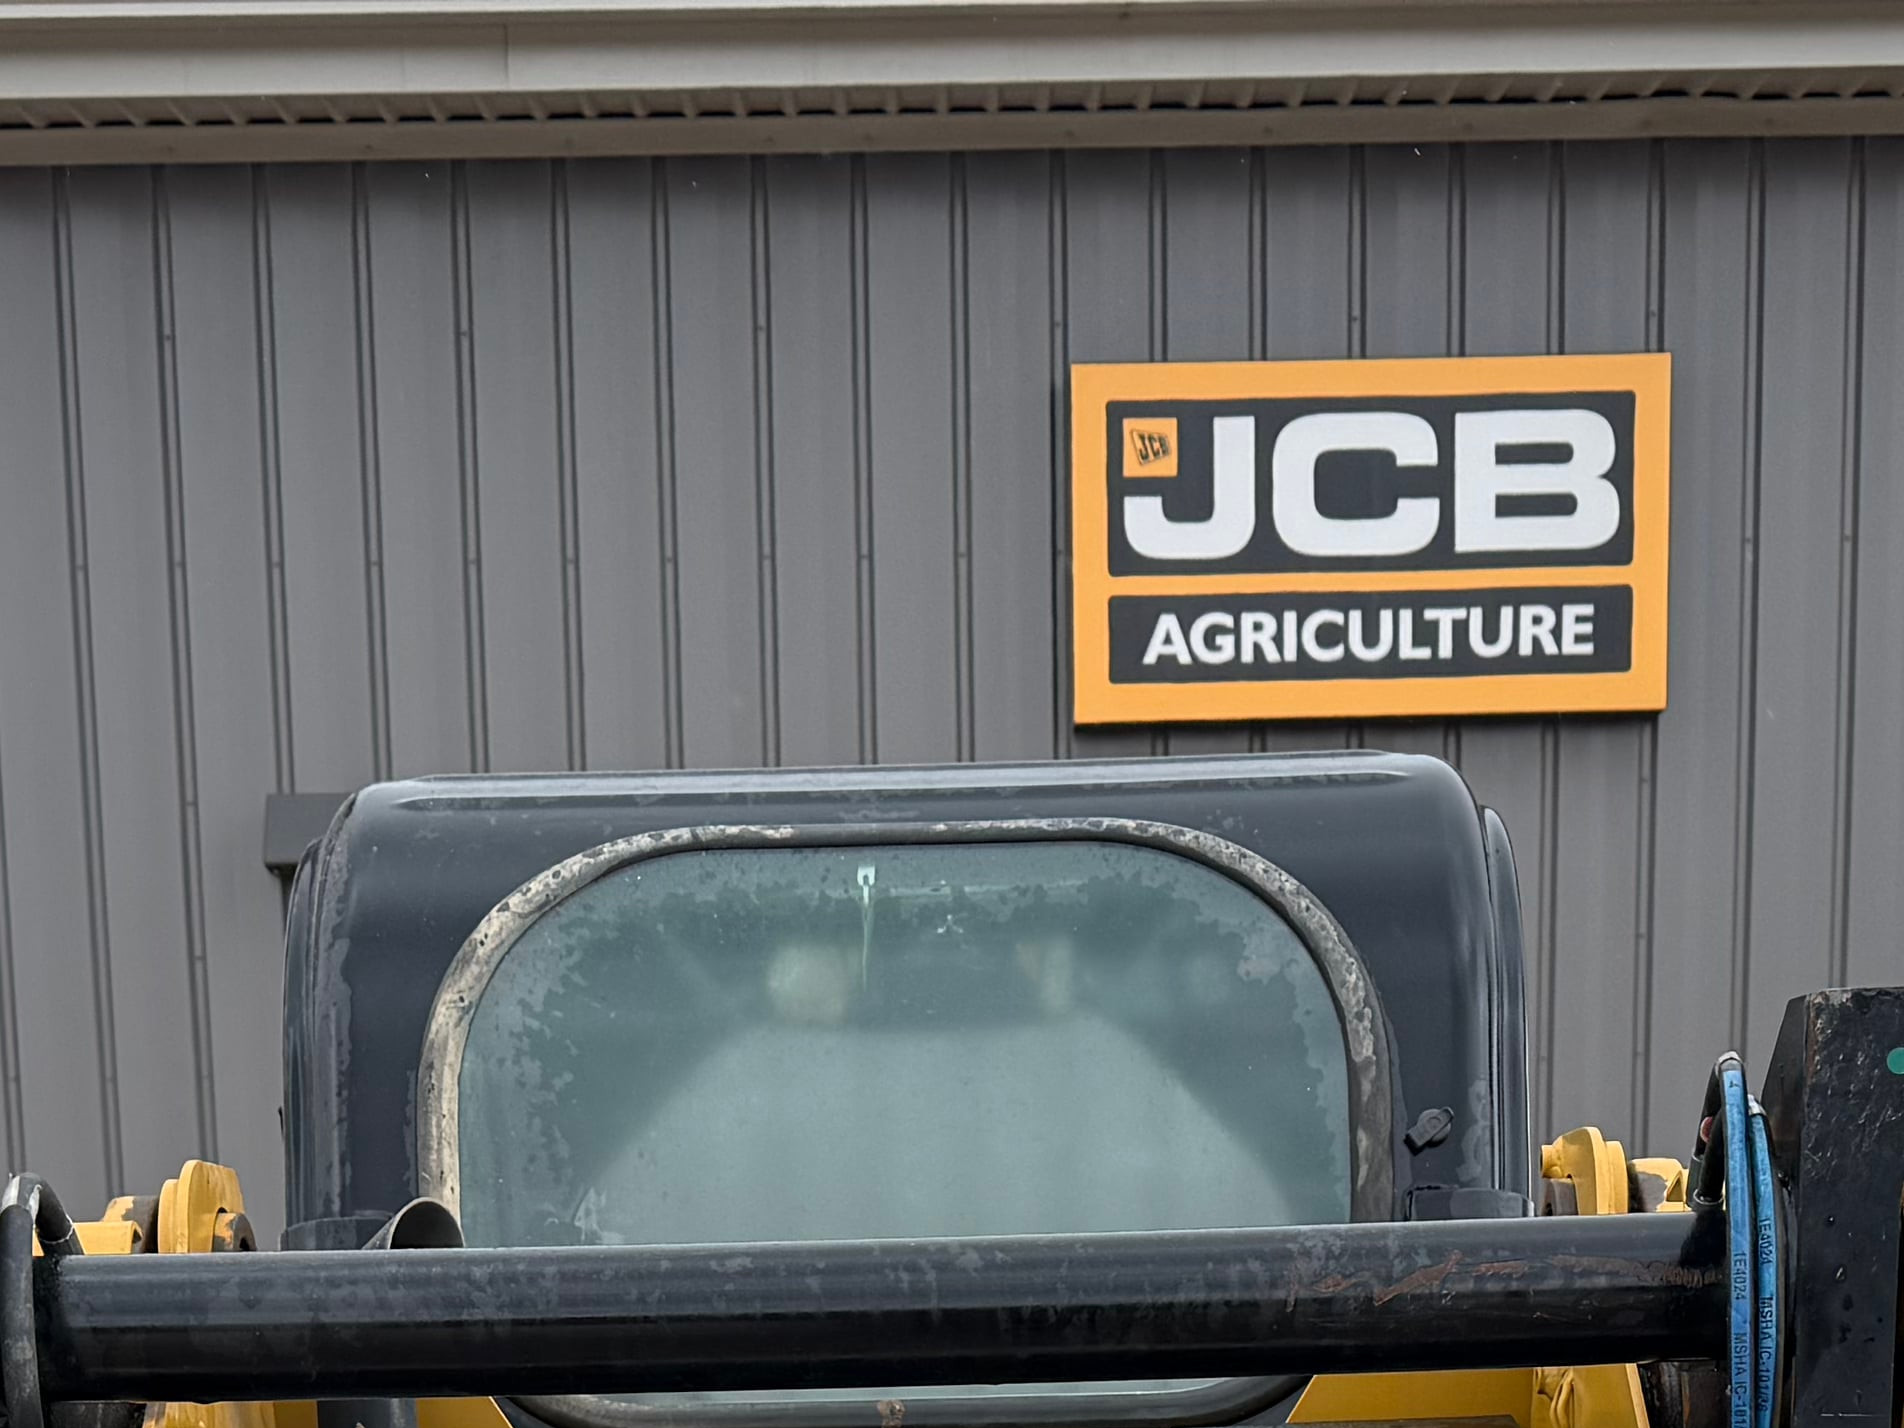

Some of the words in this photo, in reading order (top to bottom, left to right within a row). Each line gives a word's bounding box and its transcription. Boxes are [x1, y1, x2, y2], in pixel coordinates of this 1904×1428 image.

[1137, 432, 1170, 461] JCB
[1123, 408, 1621, 559] JCB
[1142, 603, 1595, 665] AGRICULTURE
[1733, 1332, 1748, 1376] MSHA
